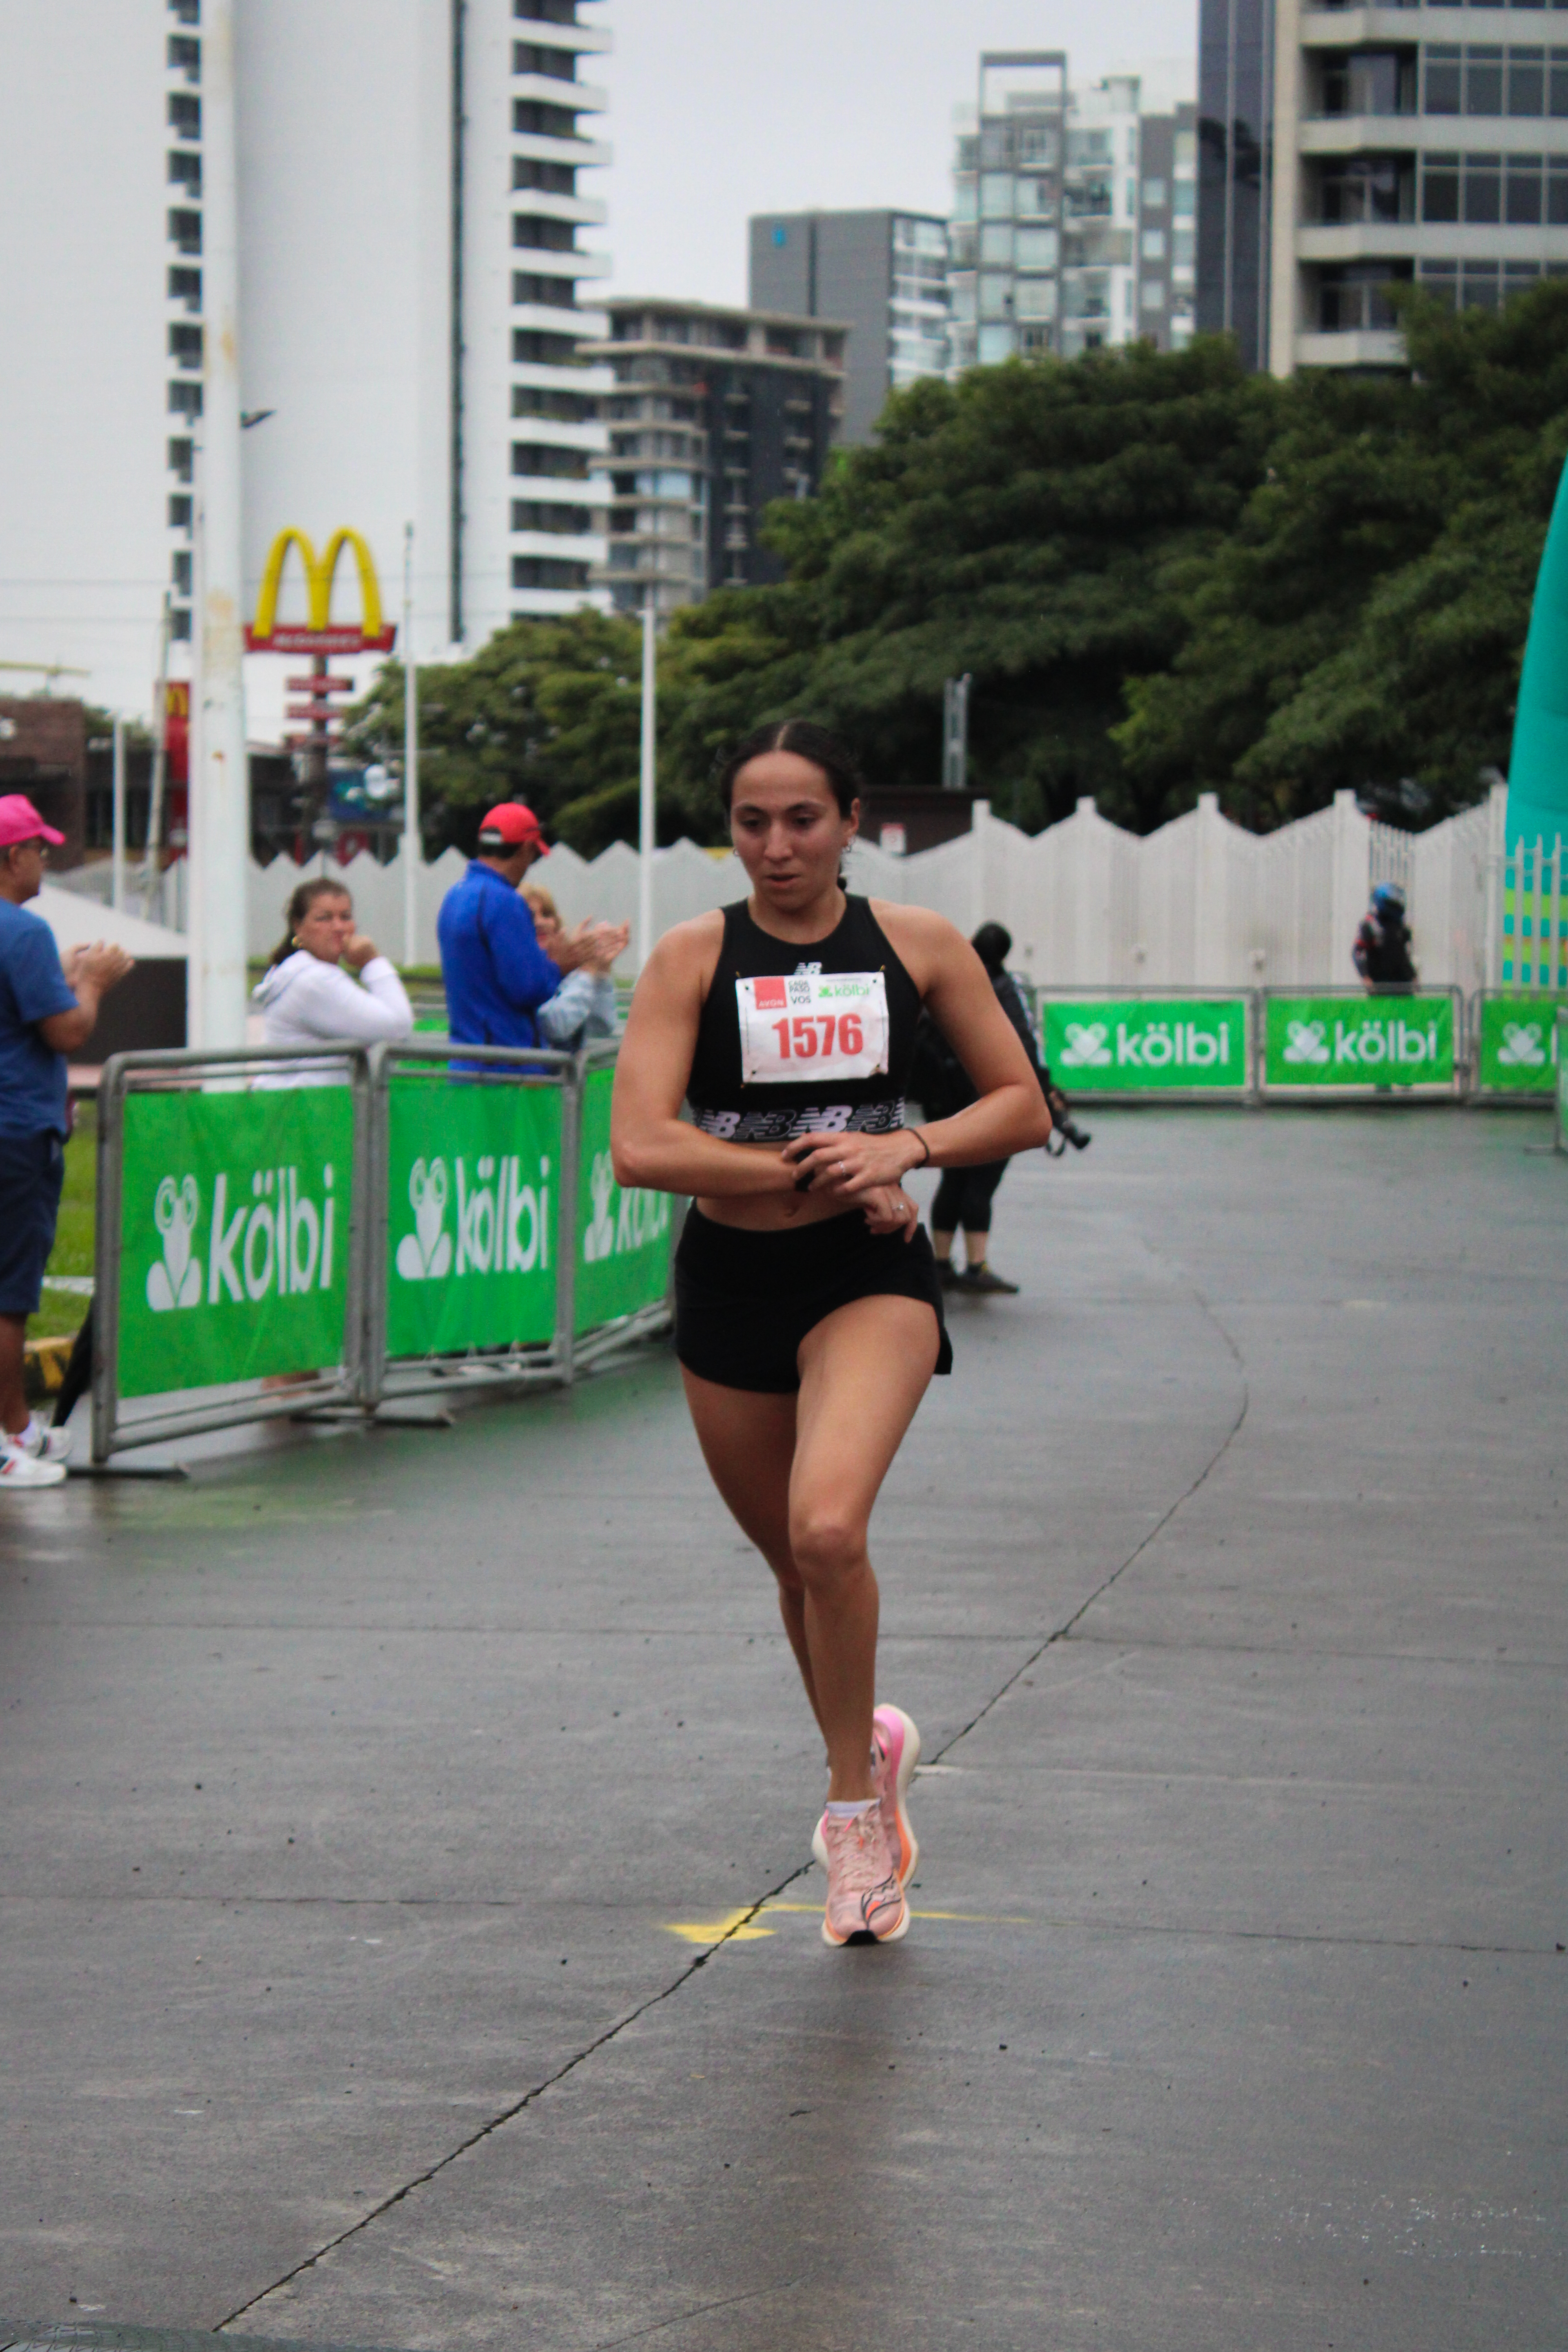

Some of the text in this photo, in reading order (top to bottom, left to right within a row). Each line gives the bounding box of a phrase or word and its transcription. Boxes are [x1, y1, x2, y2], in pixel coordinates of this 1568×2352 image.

[759, 999, 784, 1007] AVON
[791, 996, 811, 1004] VOS
[835, 984, 869, 996] kölbi
[772, 1013, 863, 1059] 1576
[1117, 1022, 1230, 1067] kölbi
[1334, 1020, 1437, 1064] kölbi
[208, 1162, 334, 1305] kölbi
[455, 1155, 549, 1275] kölbi
